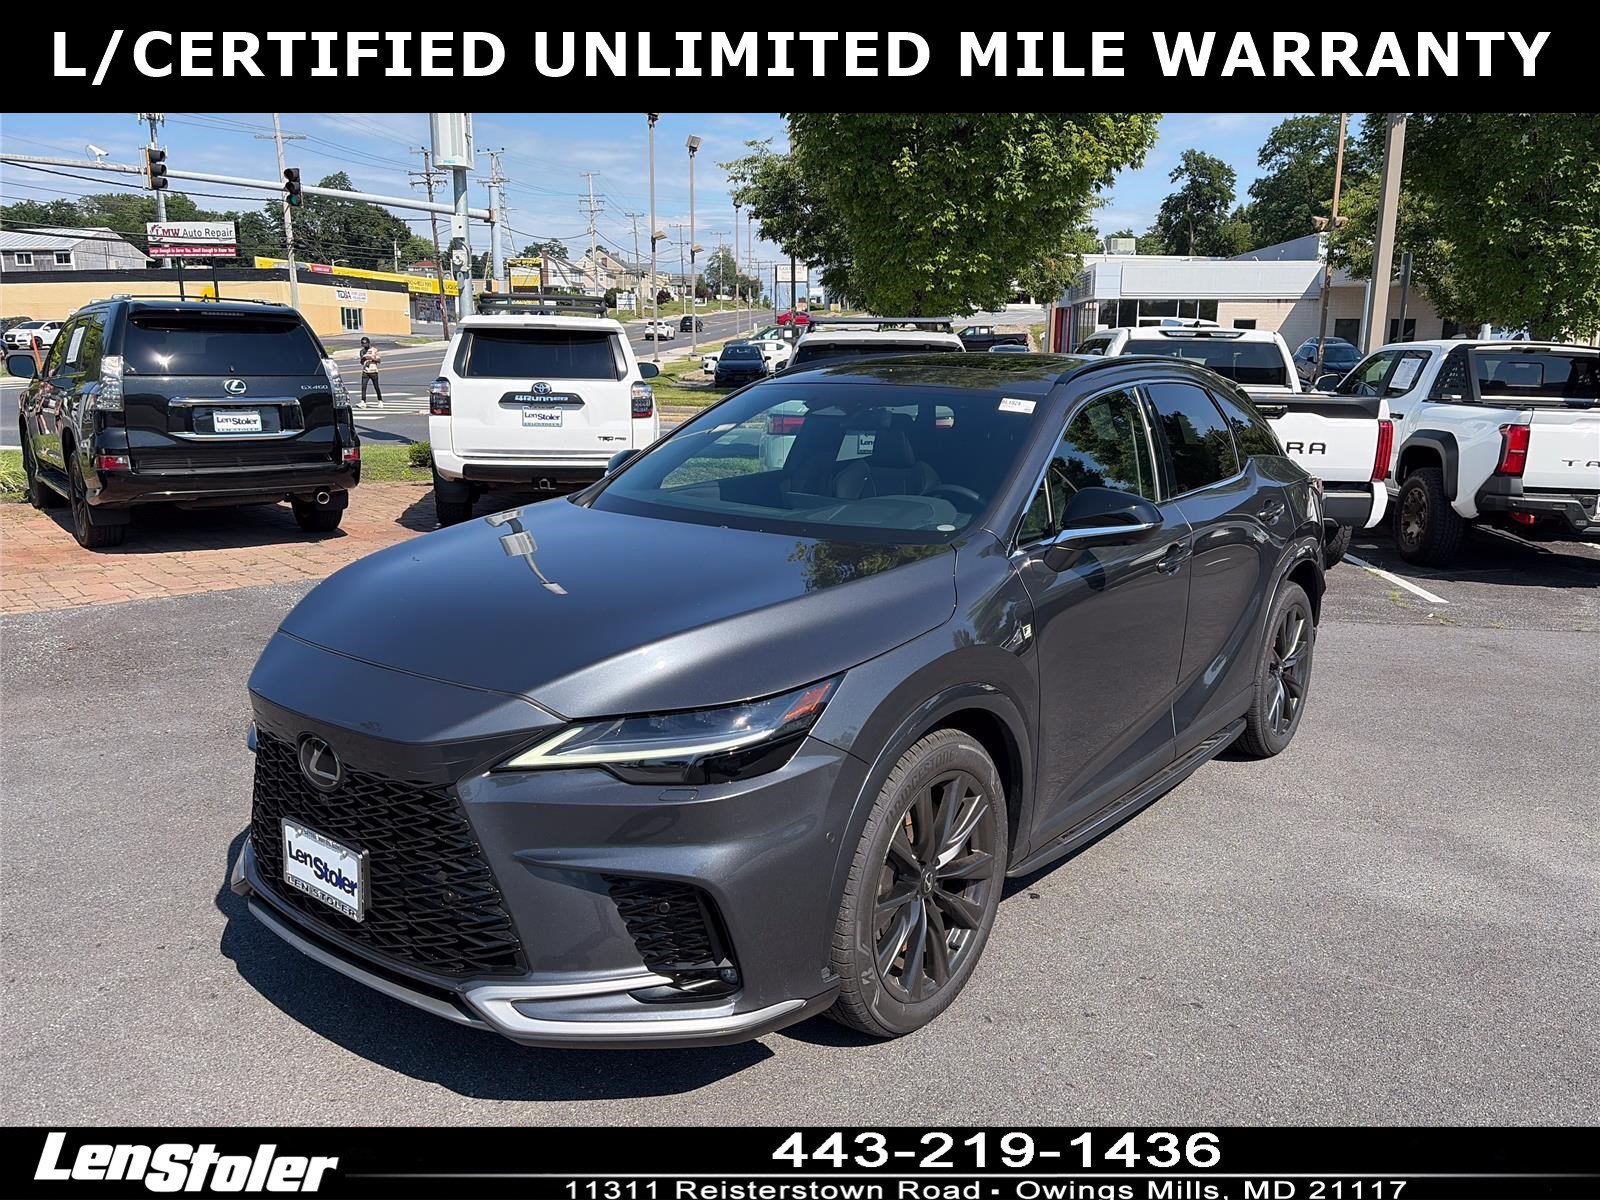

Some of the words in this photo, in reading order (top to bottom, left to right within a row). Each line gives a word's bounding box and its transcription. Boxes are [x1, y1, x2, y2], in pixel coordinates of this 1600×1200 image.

[182, 228, 202, 238] Auto
[204, 227, 233, 239] Repair
[287, 874, 310, 893] LEN
[312, 887, 358, 919] STOLER
